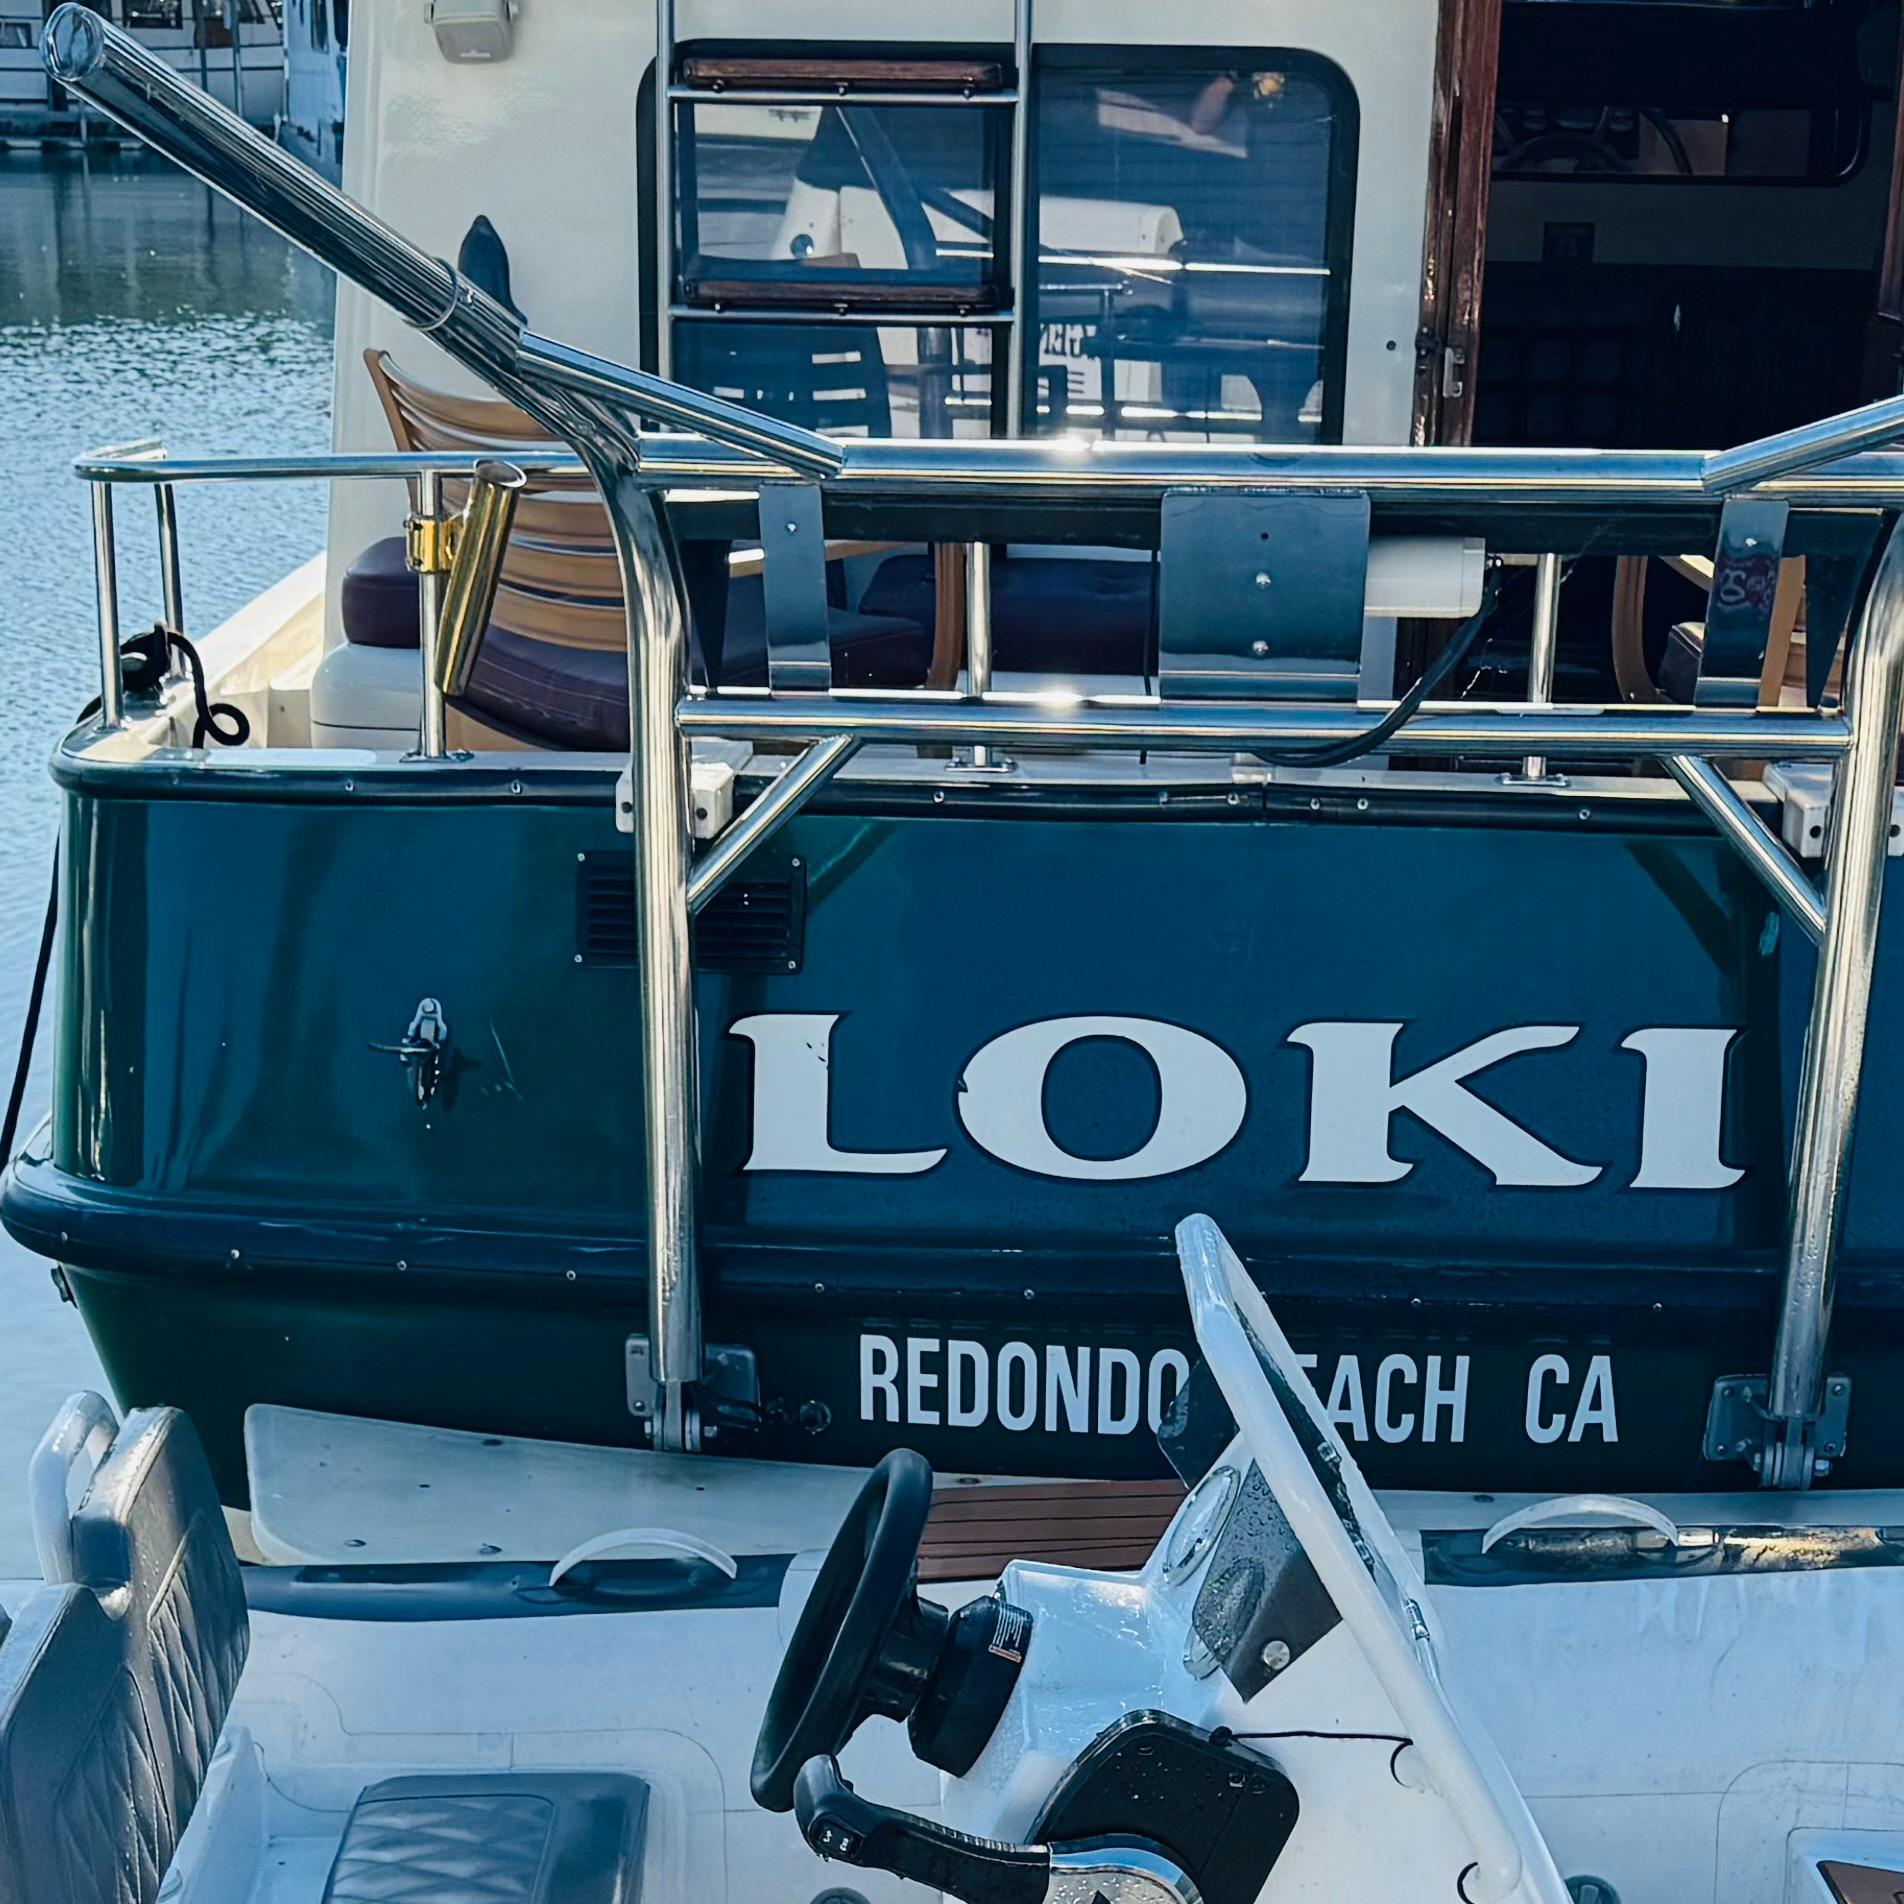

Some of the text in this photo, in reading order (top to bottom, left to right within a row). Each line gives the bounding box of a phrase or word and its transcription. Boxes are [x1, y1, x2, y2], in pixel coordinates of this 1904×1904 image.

[728, 1012, 1748, 1189] LOKI
[859, 1333, 1618, 1444] REDONDO ACH CA
